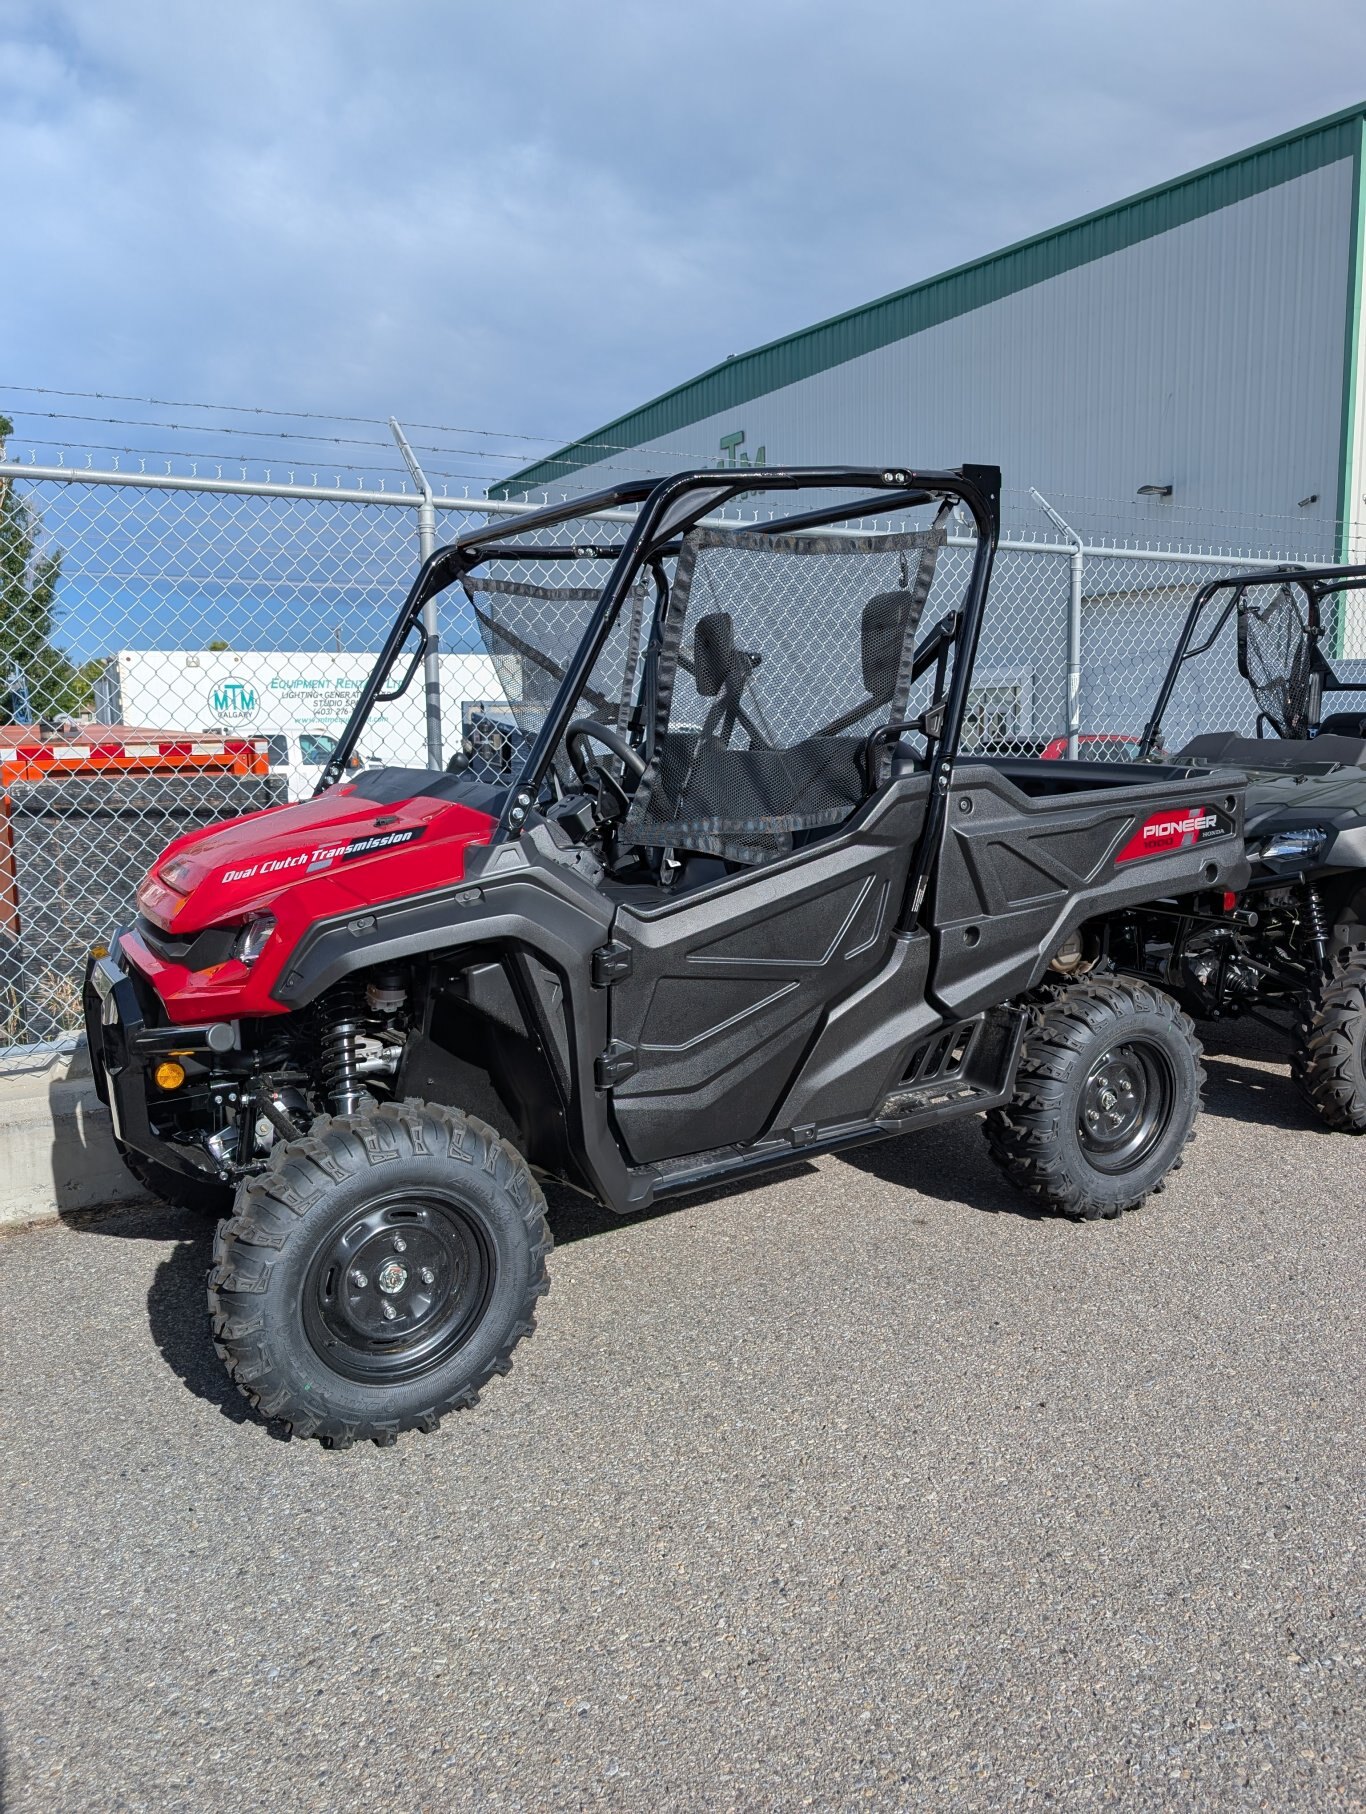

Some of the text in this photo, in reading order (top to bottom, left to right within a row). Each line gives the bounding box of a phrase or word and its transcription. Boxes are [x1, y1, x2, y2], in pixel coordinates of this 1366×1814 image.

[214, 684, 254, 710] MTM
[281, 691, 319, 699] LIGHTING
[1144, 815, 1217, 838] PIONEER
[1202, 828, 1225, 838] HONDA
[1144, 837, 1174, 848] 1000
[222, 831, 413, 883] Dual Clutch Transmission
